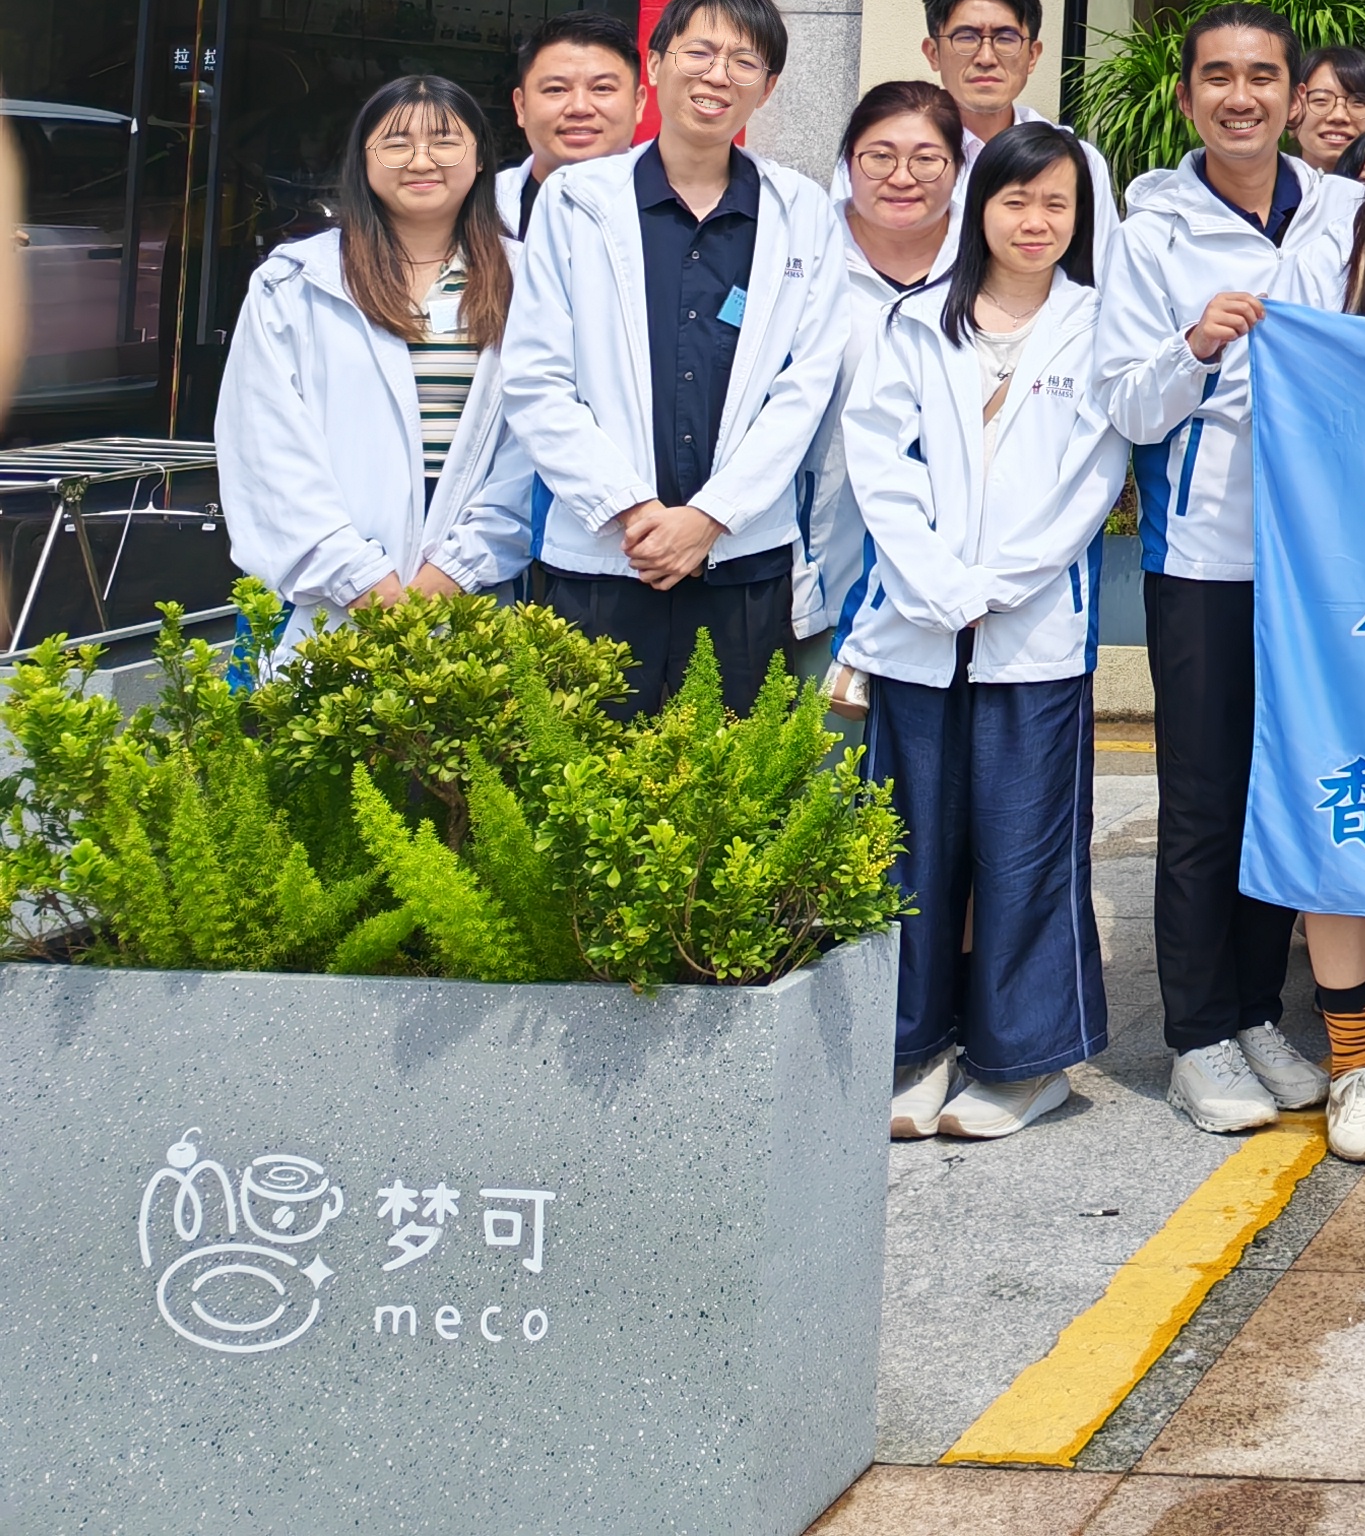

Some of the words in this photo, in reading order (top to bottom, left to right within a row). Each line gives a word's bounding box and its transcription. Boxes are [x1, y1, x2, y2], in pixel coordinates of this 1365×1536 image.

[174, 48, 190, 64] 拉
[377, 1179, 556, 1273] 梦可
[375, 1304, 549, 1341] meco
